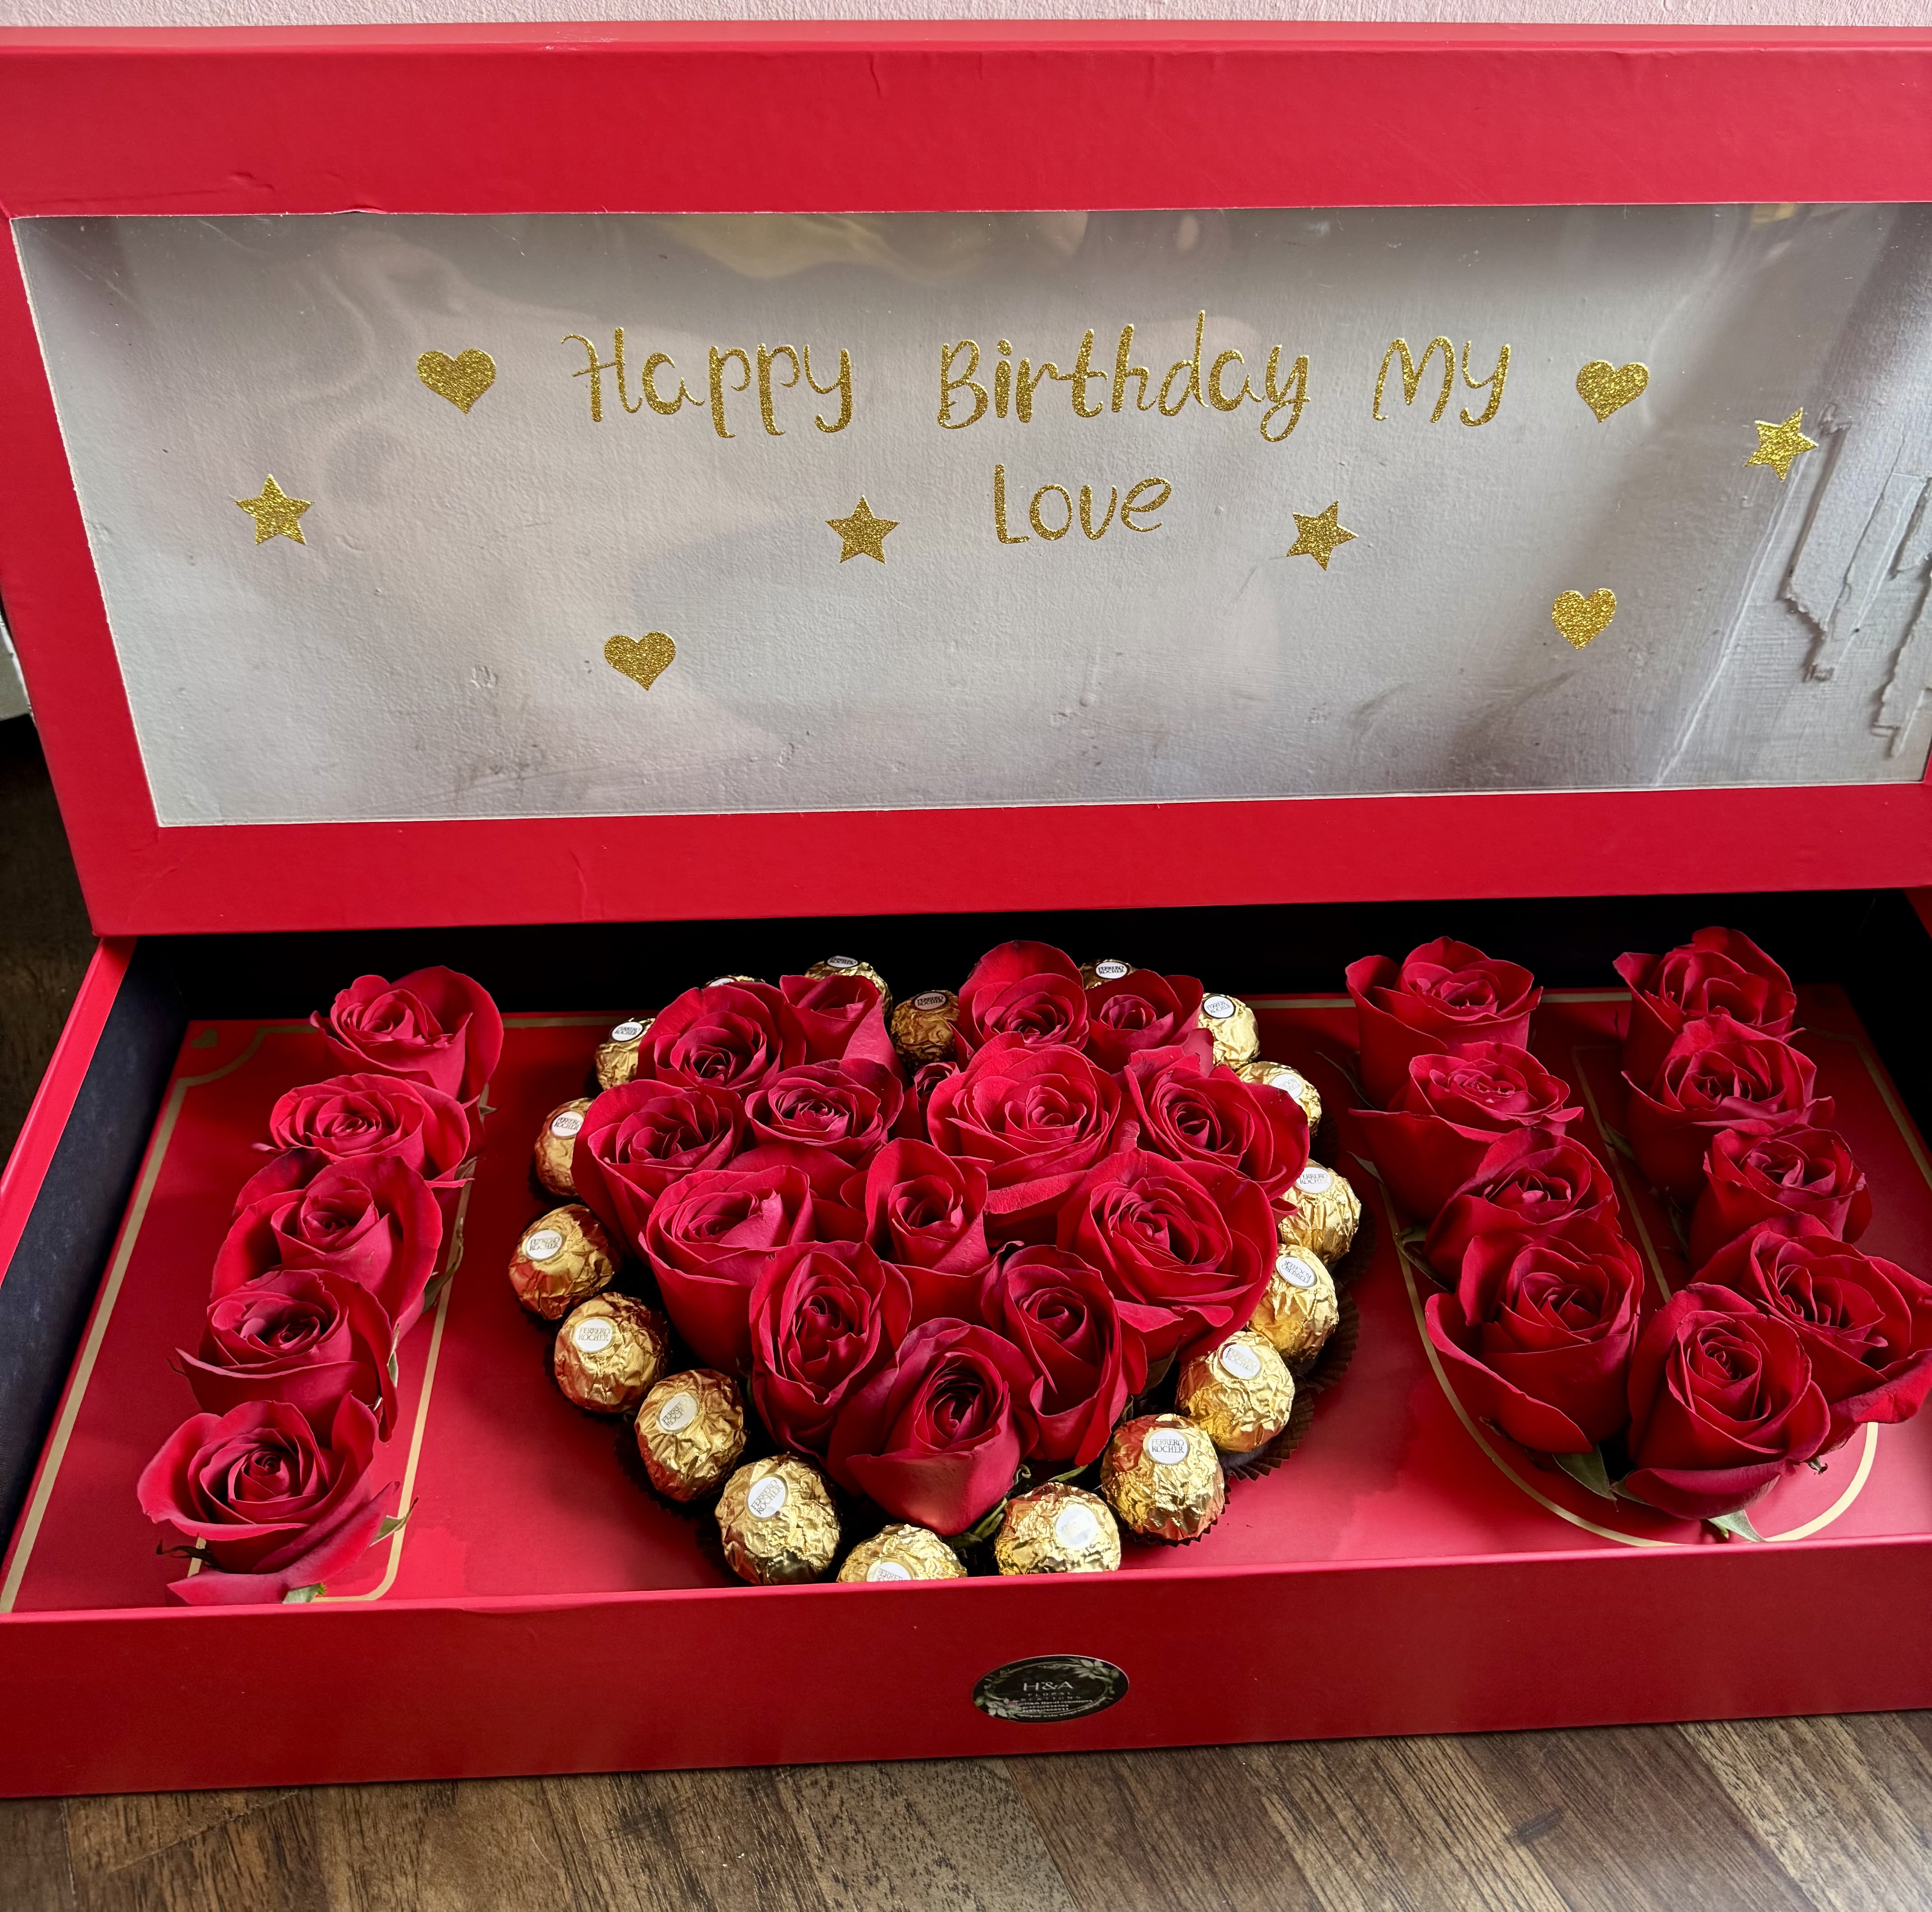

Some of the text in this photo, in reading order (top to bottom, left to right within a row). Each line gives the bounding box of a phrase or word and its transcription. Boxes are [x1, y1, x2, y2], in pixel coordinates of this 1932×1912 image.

[561, 309, 1512, 443] Happy Birthday My
[994, 463, 1173, 545] Love
[1151, 1445, 1185, 1453] ROCHER
[750, 1479, 777, 1510] FERRERO
[756, 1485, 783, 1515] ROCHER
[1023, 1681, 1074, 1691] H&A
